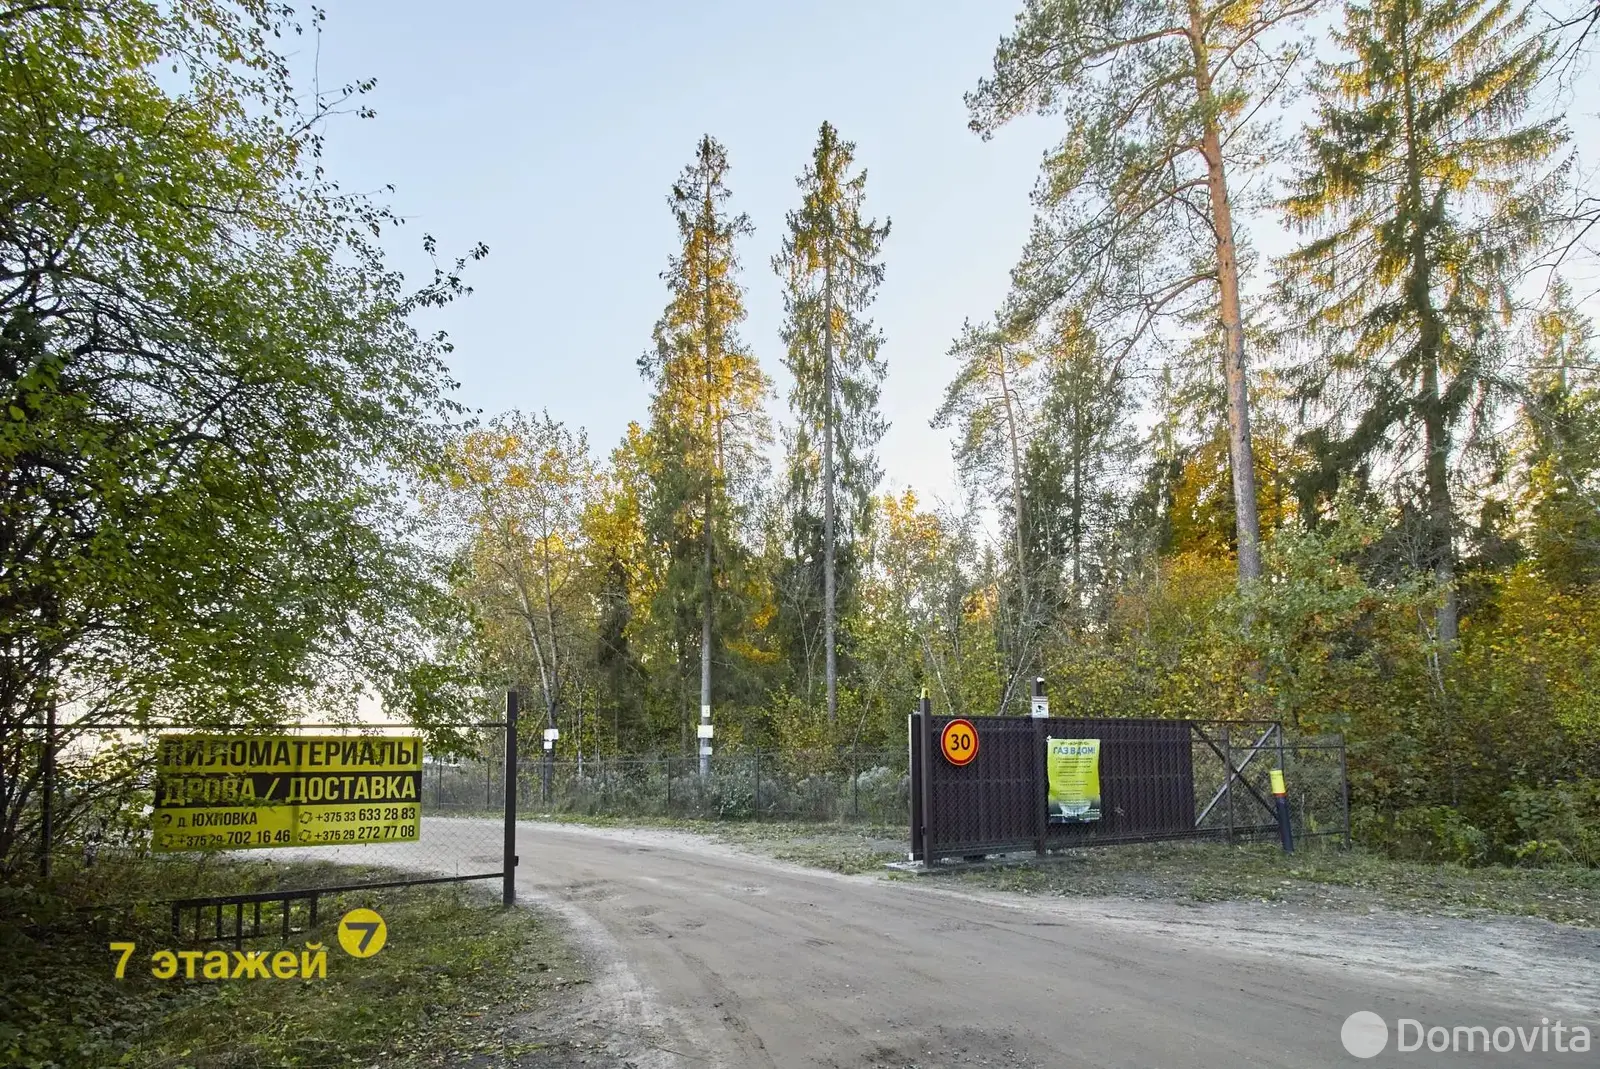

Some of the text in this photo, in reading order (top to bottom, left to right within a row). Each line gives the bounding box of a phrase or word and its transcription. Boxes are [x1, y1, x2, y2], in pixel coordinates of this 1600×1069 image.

[950, 733, 971, 751] 30
[1053, 746, 1069, 754] ГАЗ
[163, 740, 418, 767] ПИЛОМАТЕРИАЛЫ
[160, 777, 256, 806] ДРОВА
[285, 775, 417, 803] ДОСТАВКА
[316, 807, 416, 823] +375 33 633 28 83
[227, 831, 252, 845] 702
[257, 830, 271, 843] 16
[274, 829, 291, 843] 46
[315, 825, 415, 841] +375 29 272 77 08
